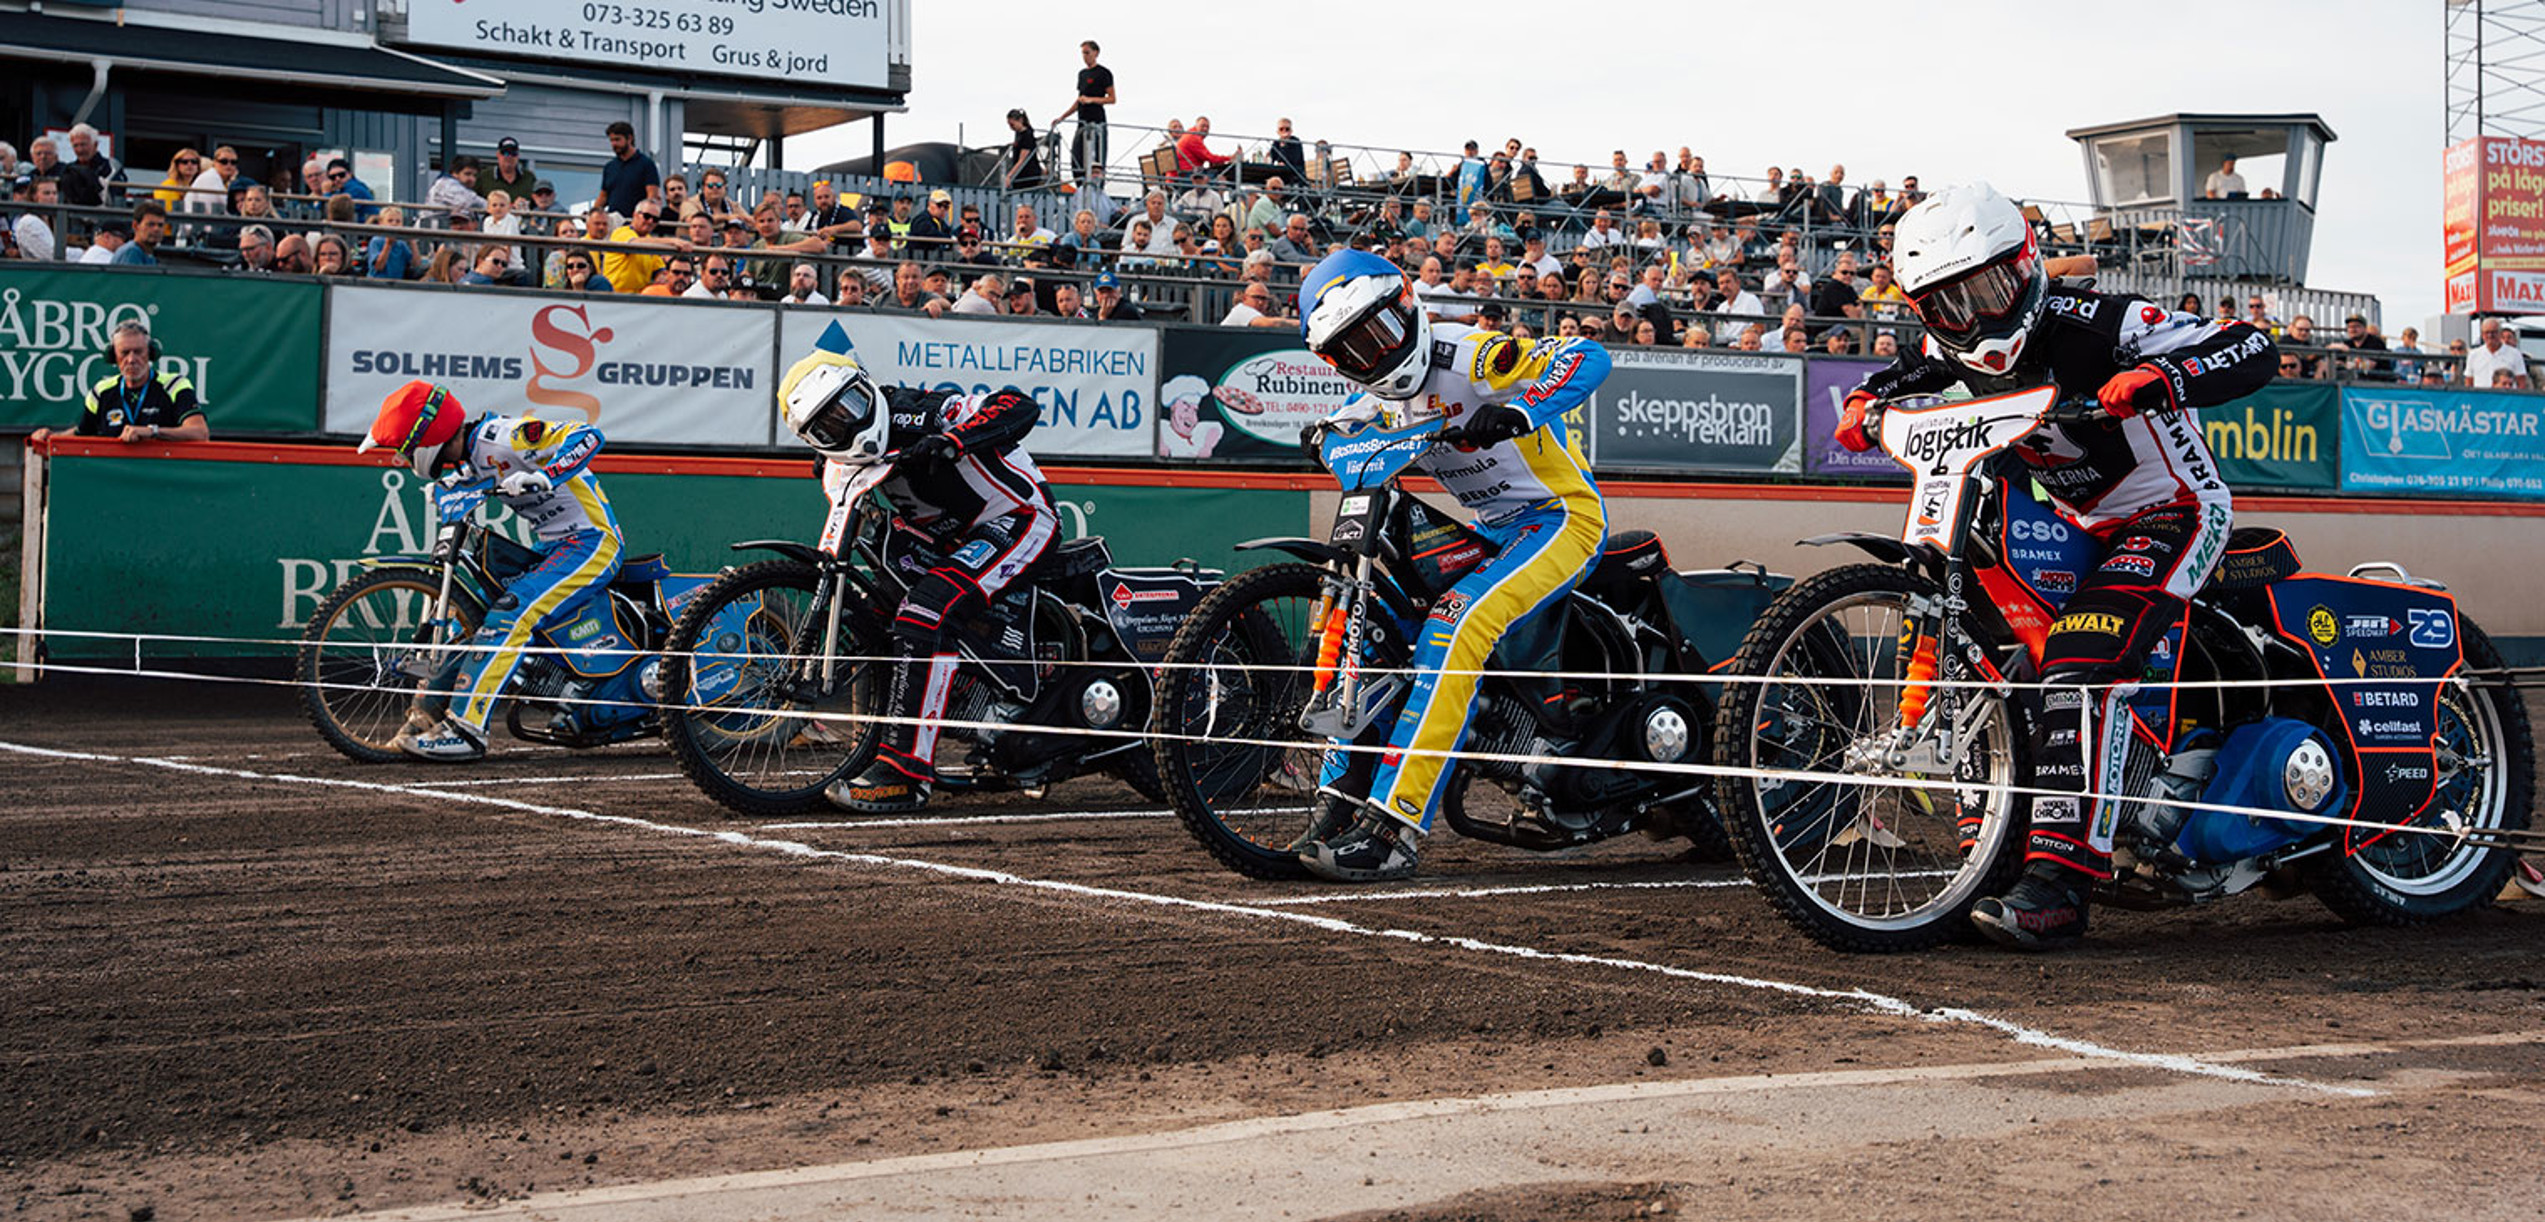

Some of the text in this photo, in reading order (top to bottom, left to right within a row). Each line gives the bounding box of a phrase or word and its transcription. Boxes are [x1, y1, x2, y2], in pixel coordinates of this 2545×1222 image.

[583, 2, 734, 36] 073-325 63 89
[475, 19, 828, 75] Schakt & Transport Grus & jord
[2487, 138, 2545, 167] STÖRS
[2488, 167, 2545, 196] på låg
[2488, 195, 2544, 220] priser!
[2497, 276, 2545, 302] MAX
[352, 350, 754, 389] SOLHEMS GRUPPEN
[897, 341, 1145, 376] METALLFABRIKEN
[1276, 361, 1340, 377] Restaur
[1643, 351, 1684, 363] arenan
[1701, 354, 1769, 369] producerad
[1087, 389, 1142, 430] AB
[1617, 390, 1772, 432] skeppsbron
[2366, 403, 2545, 440] GLASMÄSTAR
[1688, 421, 1772, 446] reklam
[1903, 416, 1993, 462] logistik
[2206, 407, 2318, 462] mblin
[1435, 455, 1498, 481] formula
[1827, 452, 1849, 465] Din
[2012, 548, 2062, 561] BRAMEX
[2040, 570, 2075, 583] MOTO
[2229, 566, 2277, 580] STUDIOS
[2369, 649, 2407, 663] AMBER
[2370, 664, 2417, 679] STUDIOS
[2364, 691, 2419, 707] BETARD
[2373, 719, 2422, 733] cellfast
[2031, 835, 2075, 852] DITTON
